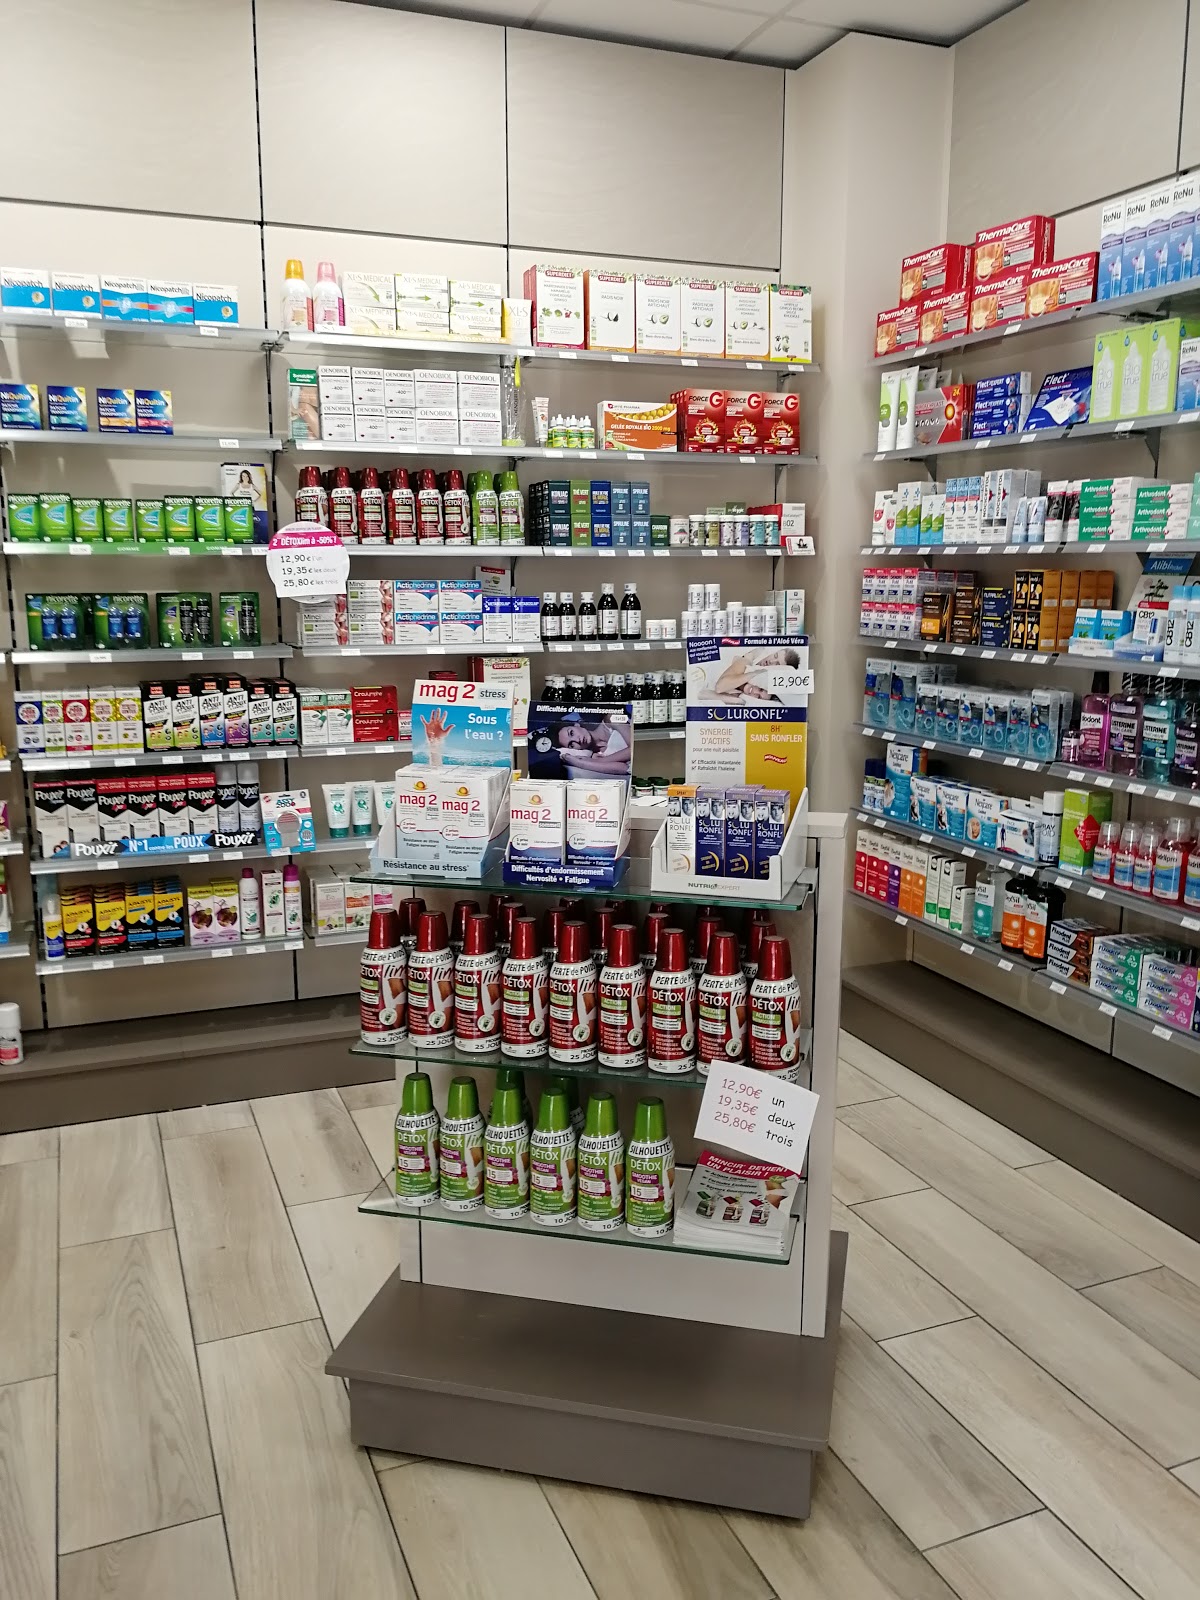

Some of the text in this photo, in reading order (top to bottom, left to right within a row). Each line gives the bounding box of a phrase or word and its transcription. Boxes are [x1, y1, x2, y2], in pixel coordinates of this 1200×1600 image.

[1173, 187, 1194, 201] ReNu
[1150, 196, 1170, 209] ReNu
[1126, 203, 1146, 217] ReNu
[1103, 211, 1122, 224] ReNu
[978, 220, 1032, 243] ThermaCare
[904, 248, 945, 268] ThermaCare
[1032, 257, 1091, 278] ThermaCare
[4, 278, 43, 288] Nicopatch
[55, 281, 93, 292] Nicopatch
[104, 280, 138, 290] Nicopatch
[975, 275, 1025, 294] ThermaCare
[150, 285, 183, 293] Nicopatch
[419, 371, 451, 380] OENOBIOL
[710, 392, 723, 407] G
[747, 393, 761, 409] G
[785, 395, 798, 410] G
[420, 409, 453, 418] OENOBIOL
[465, 411, 497, 420] OENOBIOL
[1085, 485, 1109, 493] Arthrodont
[9, 495, 39, 503] nicorette
[40, 494, 69, 502] nicorette
[104, 499, 131, 507] nicorette
[1151, 560, 1170, 571] Alibi
[1138, 611, 1154, 619] CB12
[1166, 620, 1174, 646] CB12
[1185, 621, 1194, 647] CB12
[773, 676, 809, 688] 12,90€
[420, 684, 506, 702] mag 2 stress
[536, 705, 624, 714] Difficultés d'endormissement
[468, 713, 497, 724] Sous
[465, 729, 494, 740] l'eau
[751, 734, 769, 742] SANS
[889, 749, 909, 762] Nexcare
[67, 788, 95, 798] Pouxit
[916, 783, 930, 794] Nexcare
[35, 790, 64, 801] Pouxit
[400, 794, 437, 808] mag 2
[943, 791, 959, 801] Nexcare
[442, 800, 480, 814] mag 2
[975, 799, 993, 810] Nexcare
[511, 809, 551, 823] mag 2
[568, 809, 607, 822] mag 2
[129, 839, 148, 852] N°1
[174, 835, 204, 848] POUX
[214, 832, 255, 848] Pouxit
[75, 842, 118, 858] Pouxit
[384, 860, 427, 870] Résistance
[511, 865, 604, 875] Difficultés d'endormissement
[526, 875, 589, 884] Nervosité Fatigue
[1052, 926, 1072, 940] Fixodent
[1049, 943, 1071, 956] Fixodent
[427, 956, 434, 964] de
[457, 958, 474, 967] PERTE
[476, 959, 483, 967] de
[1049, 959, 1070, 972] Fixodent
[552, 967, 569, 975] PERTE
[604, 971, 633, 980] PERTE de
[504, 976, 531, 988] DÉTOX
[655, 975, 687, 985] PERTE de
[702, 979, 733, 988] PERTE de
[550, 980, 575, 992] DÉTOX
[601, 984, 630, 997] DÉTOX
[755, 984, 786, 994] PERTE de
[652, 990, 683, 1002] DÉTOX
[722, 1078, 785, 1108] 12,90€ un
[718, 1095, 796, 1130] 19,35€ deux
[714, 1111, 793, 1147] 25,80€ trois
[487, 1169, 496, 1178] 15
[707, 1161, 721, 1169] UN
[723, 1167, 761, 1176] PLAISIR
[533, 1175, 540, 1185] 15
[581, 1180, 588, 1189] 15
[633, 1187, 641, 1196] 15
